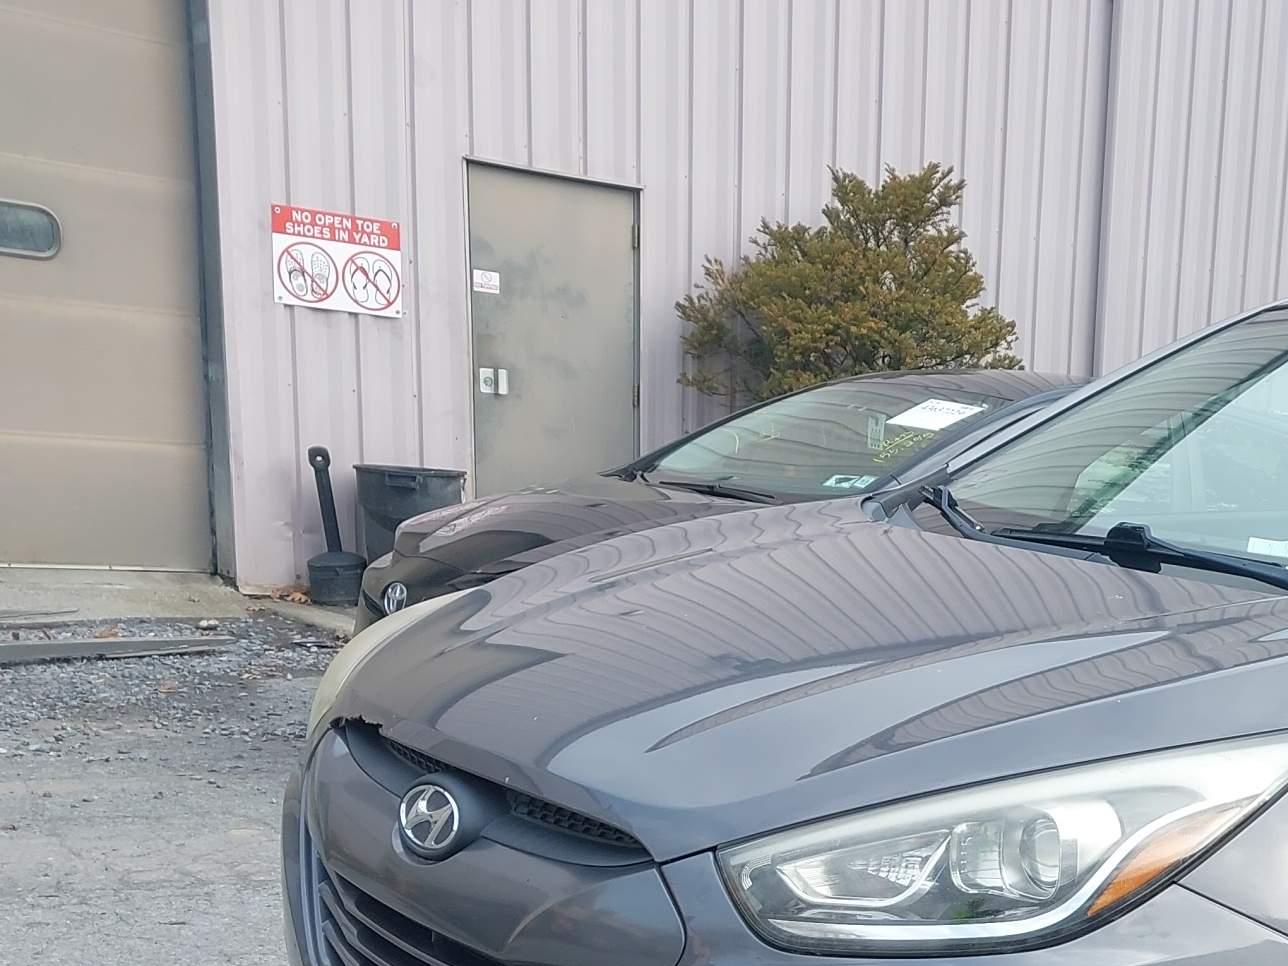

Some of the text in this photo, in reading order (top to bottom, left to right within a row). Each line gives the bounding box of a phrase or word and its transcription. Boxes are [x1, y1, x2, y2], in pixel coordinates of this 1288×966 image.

[285, 221, 388, 247] SHOES IN YARD
[292, 210, 381, 234] NO OPEN TOE
